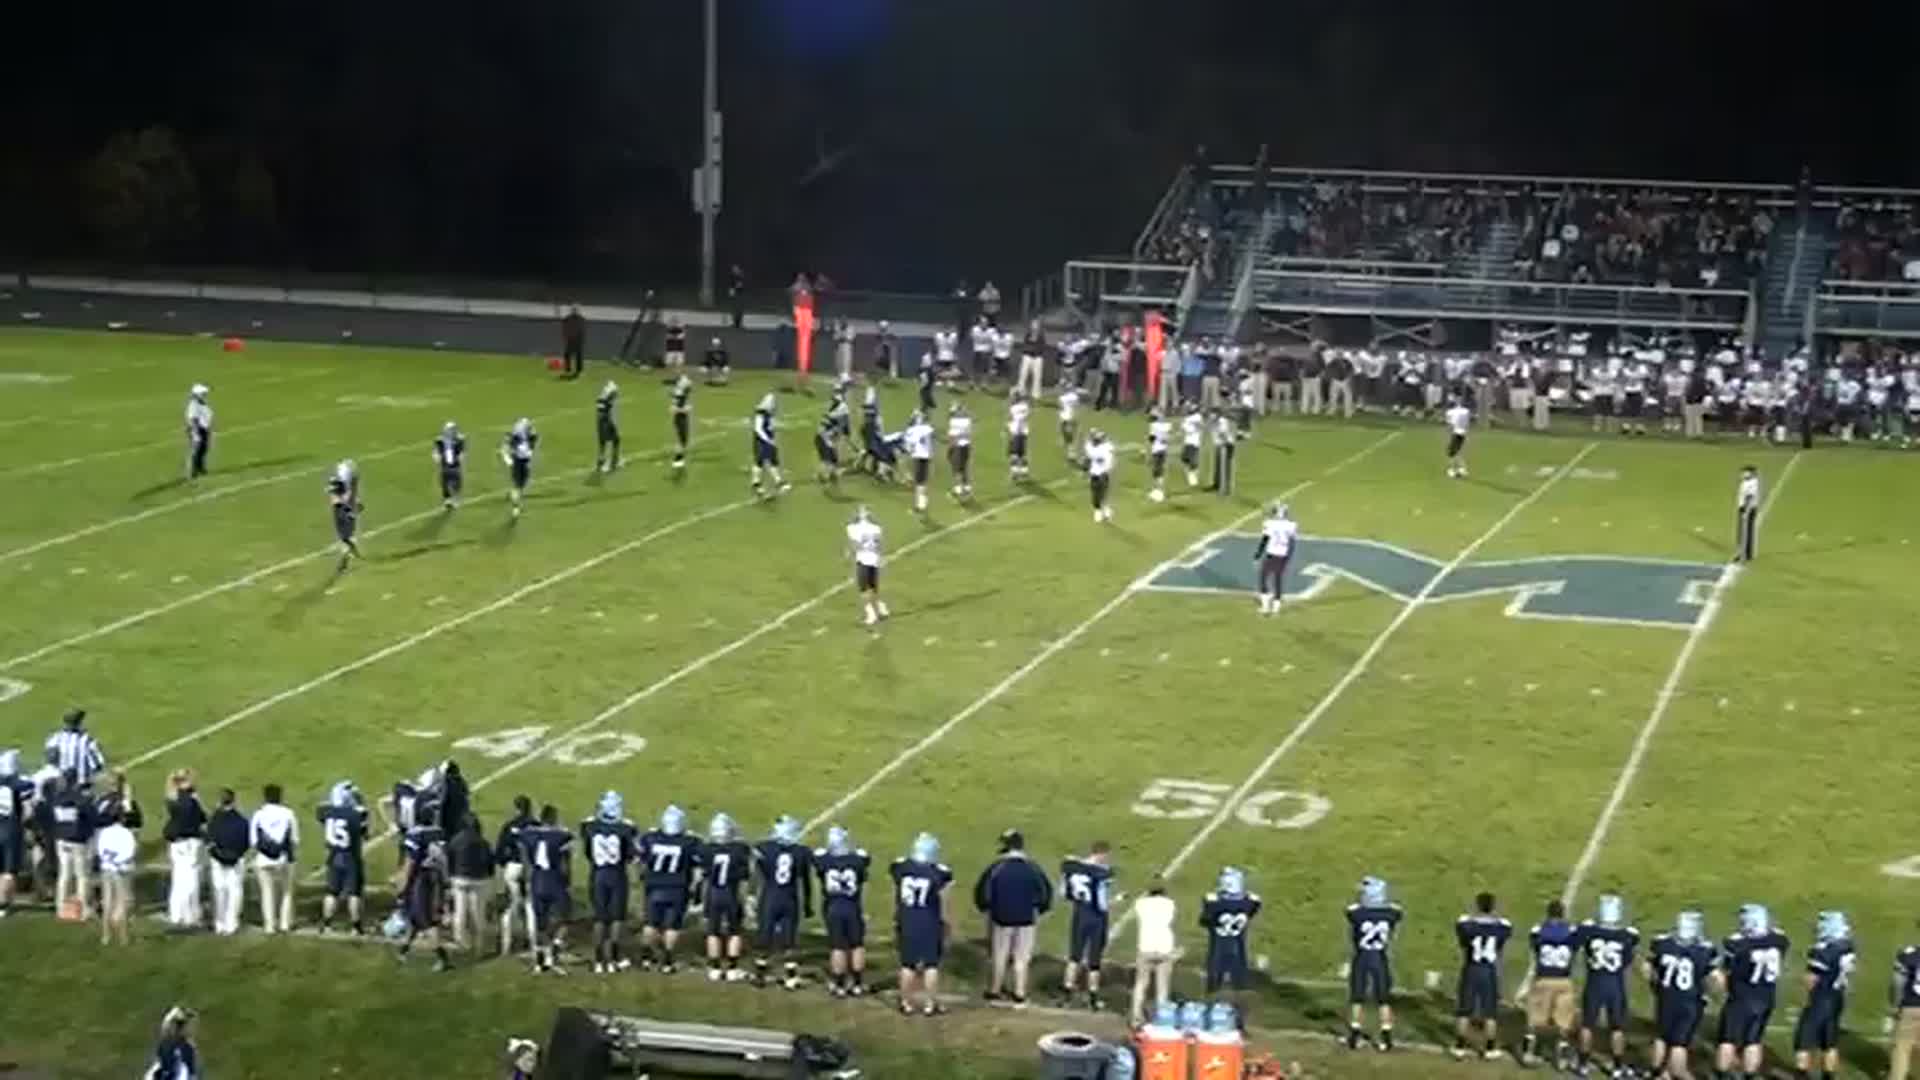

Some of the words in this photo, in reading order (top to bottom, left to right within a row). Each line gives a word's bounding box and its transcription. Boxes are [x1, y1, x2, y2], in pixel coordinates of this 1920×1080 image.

[453, 725, 646, 766] 40
[1131, 779, 1334, 829] 50
[651, 843, 681, 873] 77
[713, 853, 730, 886] 7
[775, 854, 793, 885] 8
[901, 876, 931, 907] 67
[1471, 935, 1497, 964] 14
[1588, 938, 1623, 972] 35
[1660, 953, 1694, 990] 78
